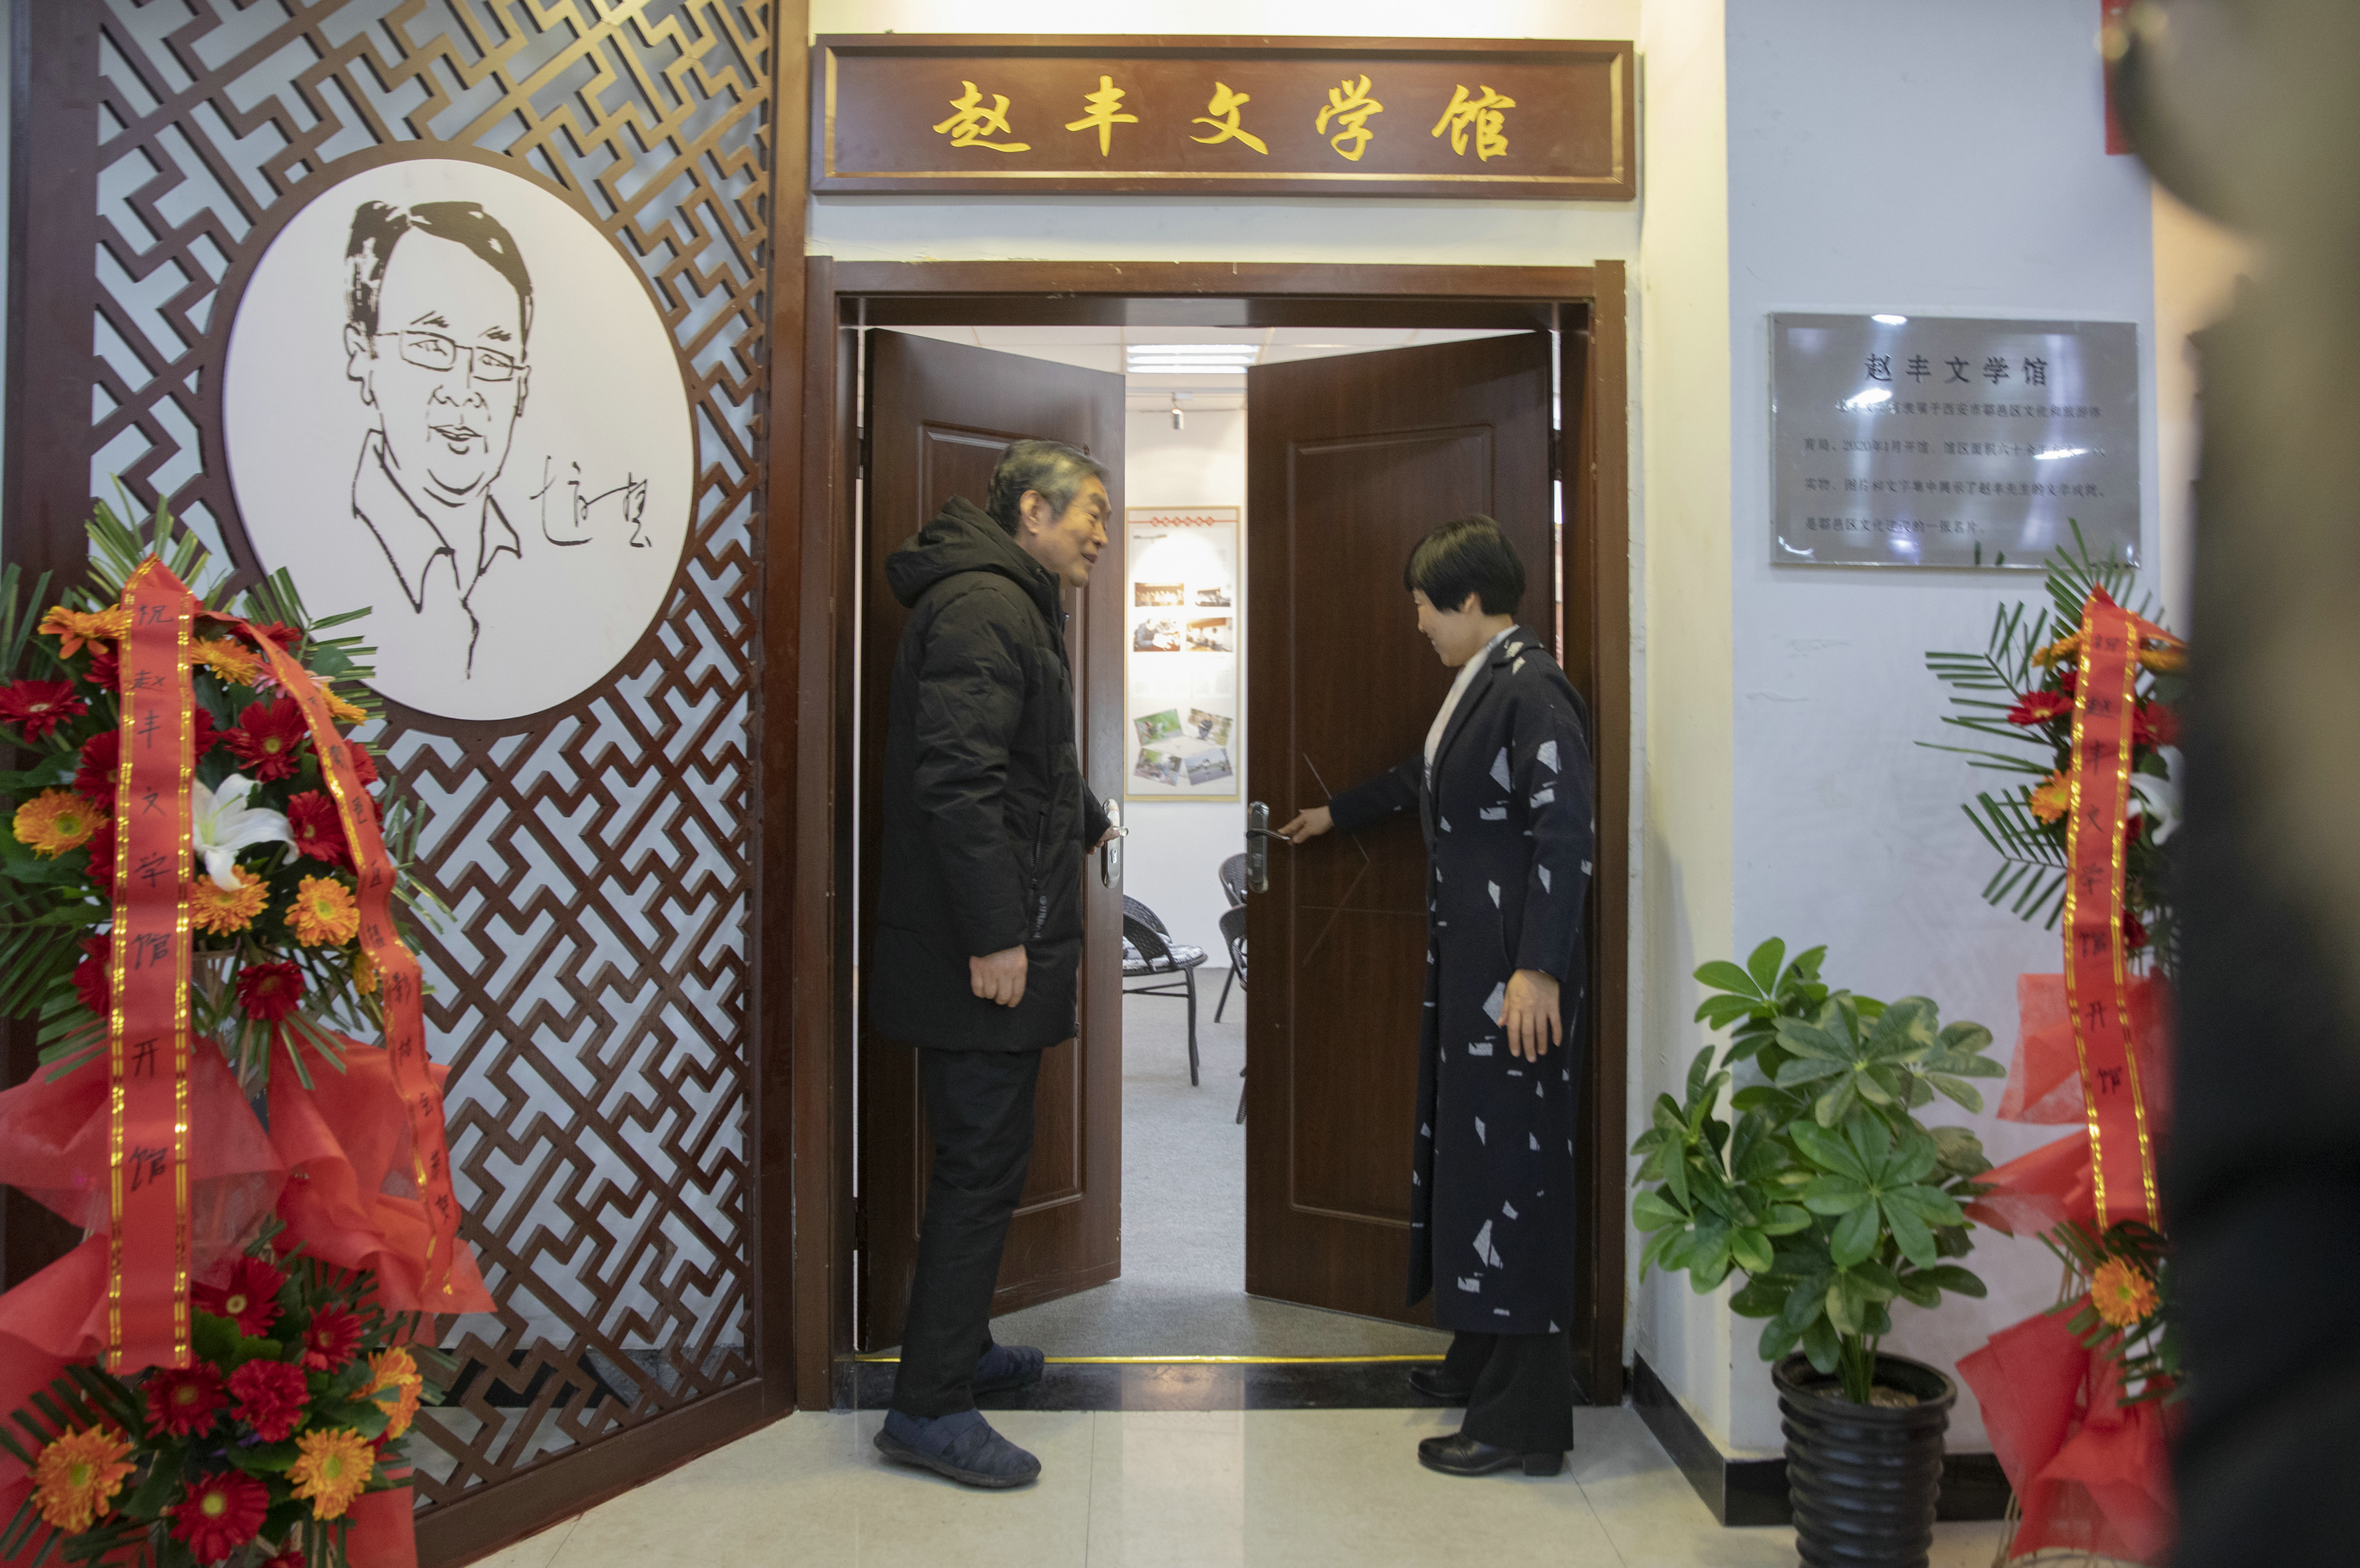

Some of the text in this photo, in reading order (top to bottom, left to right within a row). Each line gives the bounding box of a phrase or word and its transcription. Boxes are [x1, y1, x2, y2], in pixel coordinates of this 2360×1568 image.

[932, 74, 1517, 162] 赵丰文学馆
[1864, 353, 2048, 386] 赵丰文学馆
[128, 603, 174, 1192] 祝赵丰文学馆开馆
